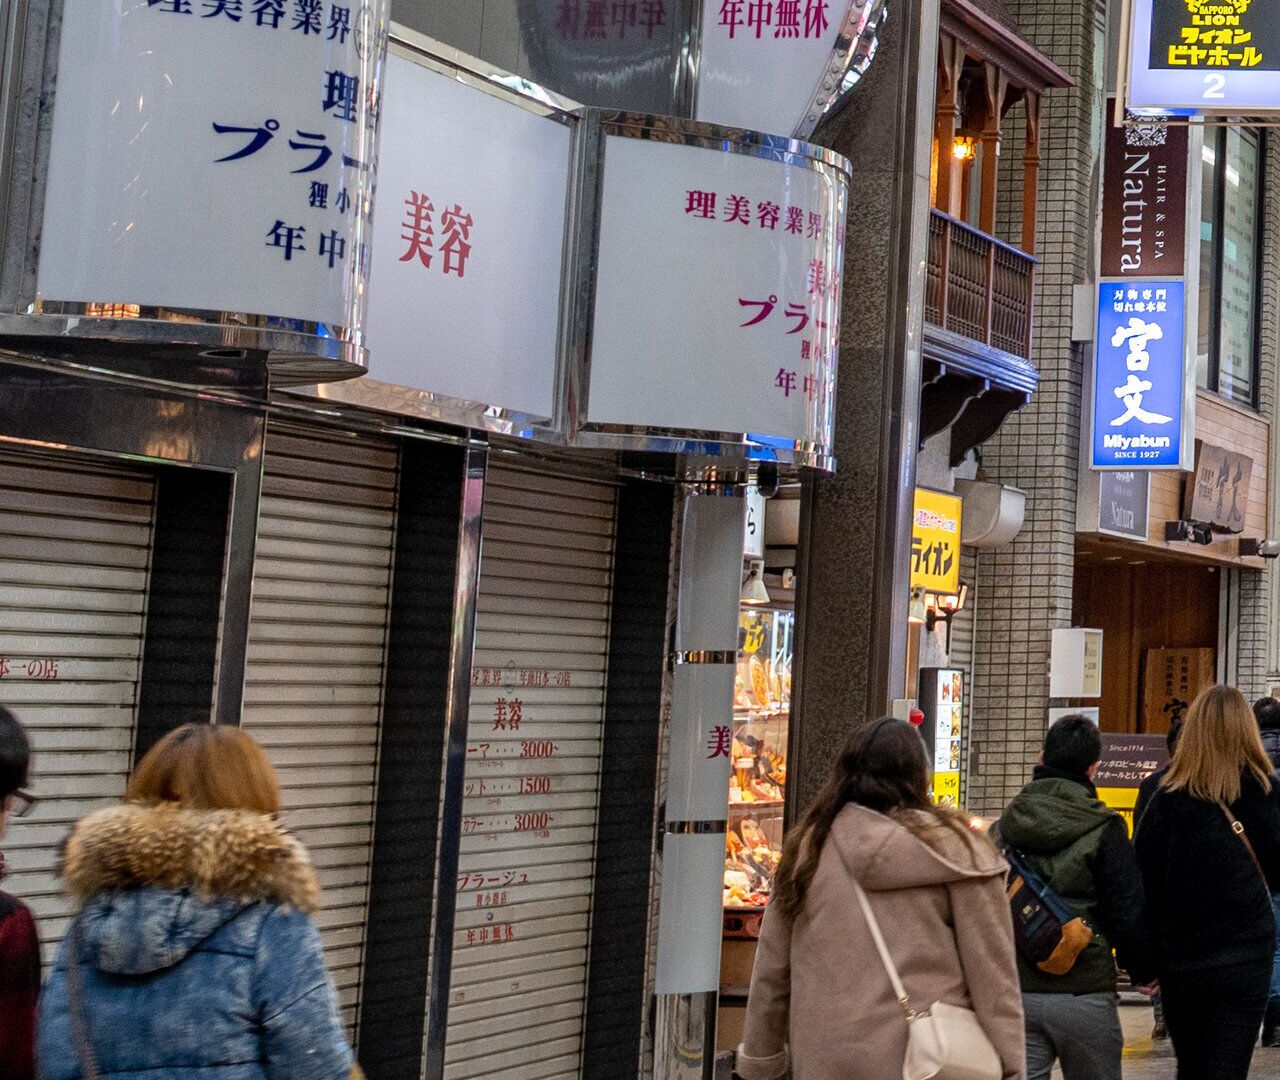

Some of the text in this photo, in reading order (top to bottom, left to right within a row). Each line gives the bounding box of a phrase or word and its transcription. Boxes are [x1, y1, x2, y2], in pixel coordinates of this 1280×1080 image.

[1192, 15, 1240, 26] LION
[1199, 5, 1234, 15] SAPPORO
[1181, 28, 1252, 45] ライオン
[1168, 45, 1263, 67] ビヤホール
[1202, 73, 1226, 99] 2
[1156, 165, 1167, 205] HAIR
[685, 189, 822, 241] 理美容業界
[1120, 152, 1150, 274] Natura
[399, 190, 473, 278] 美容
[1154, 230, 1165, 260] SPA
[1110, 317, 1173, 427] 宮文
[1103, 434, 1170, 448] Miyabun
[1114, 451, 1160, 459] SINCE 1927
[493, 698, 522, 731] 美容
[518, 777, 551, 794] 1500
[467, 923, 513, 947] 年中無休
